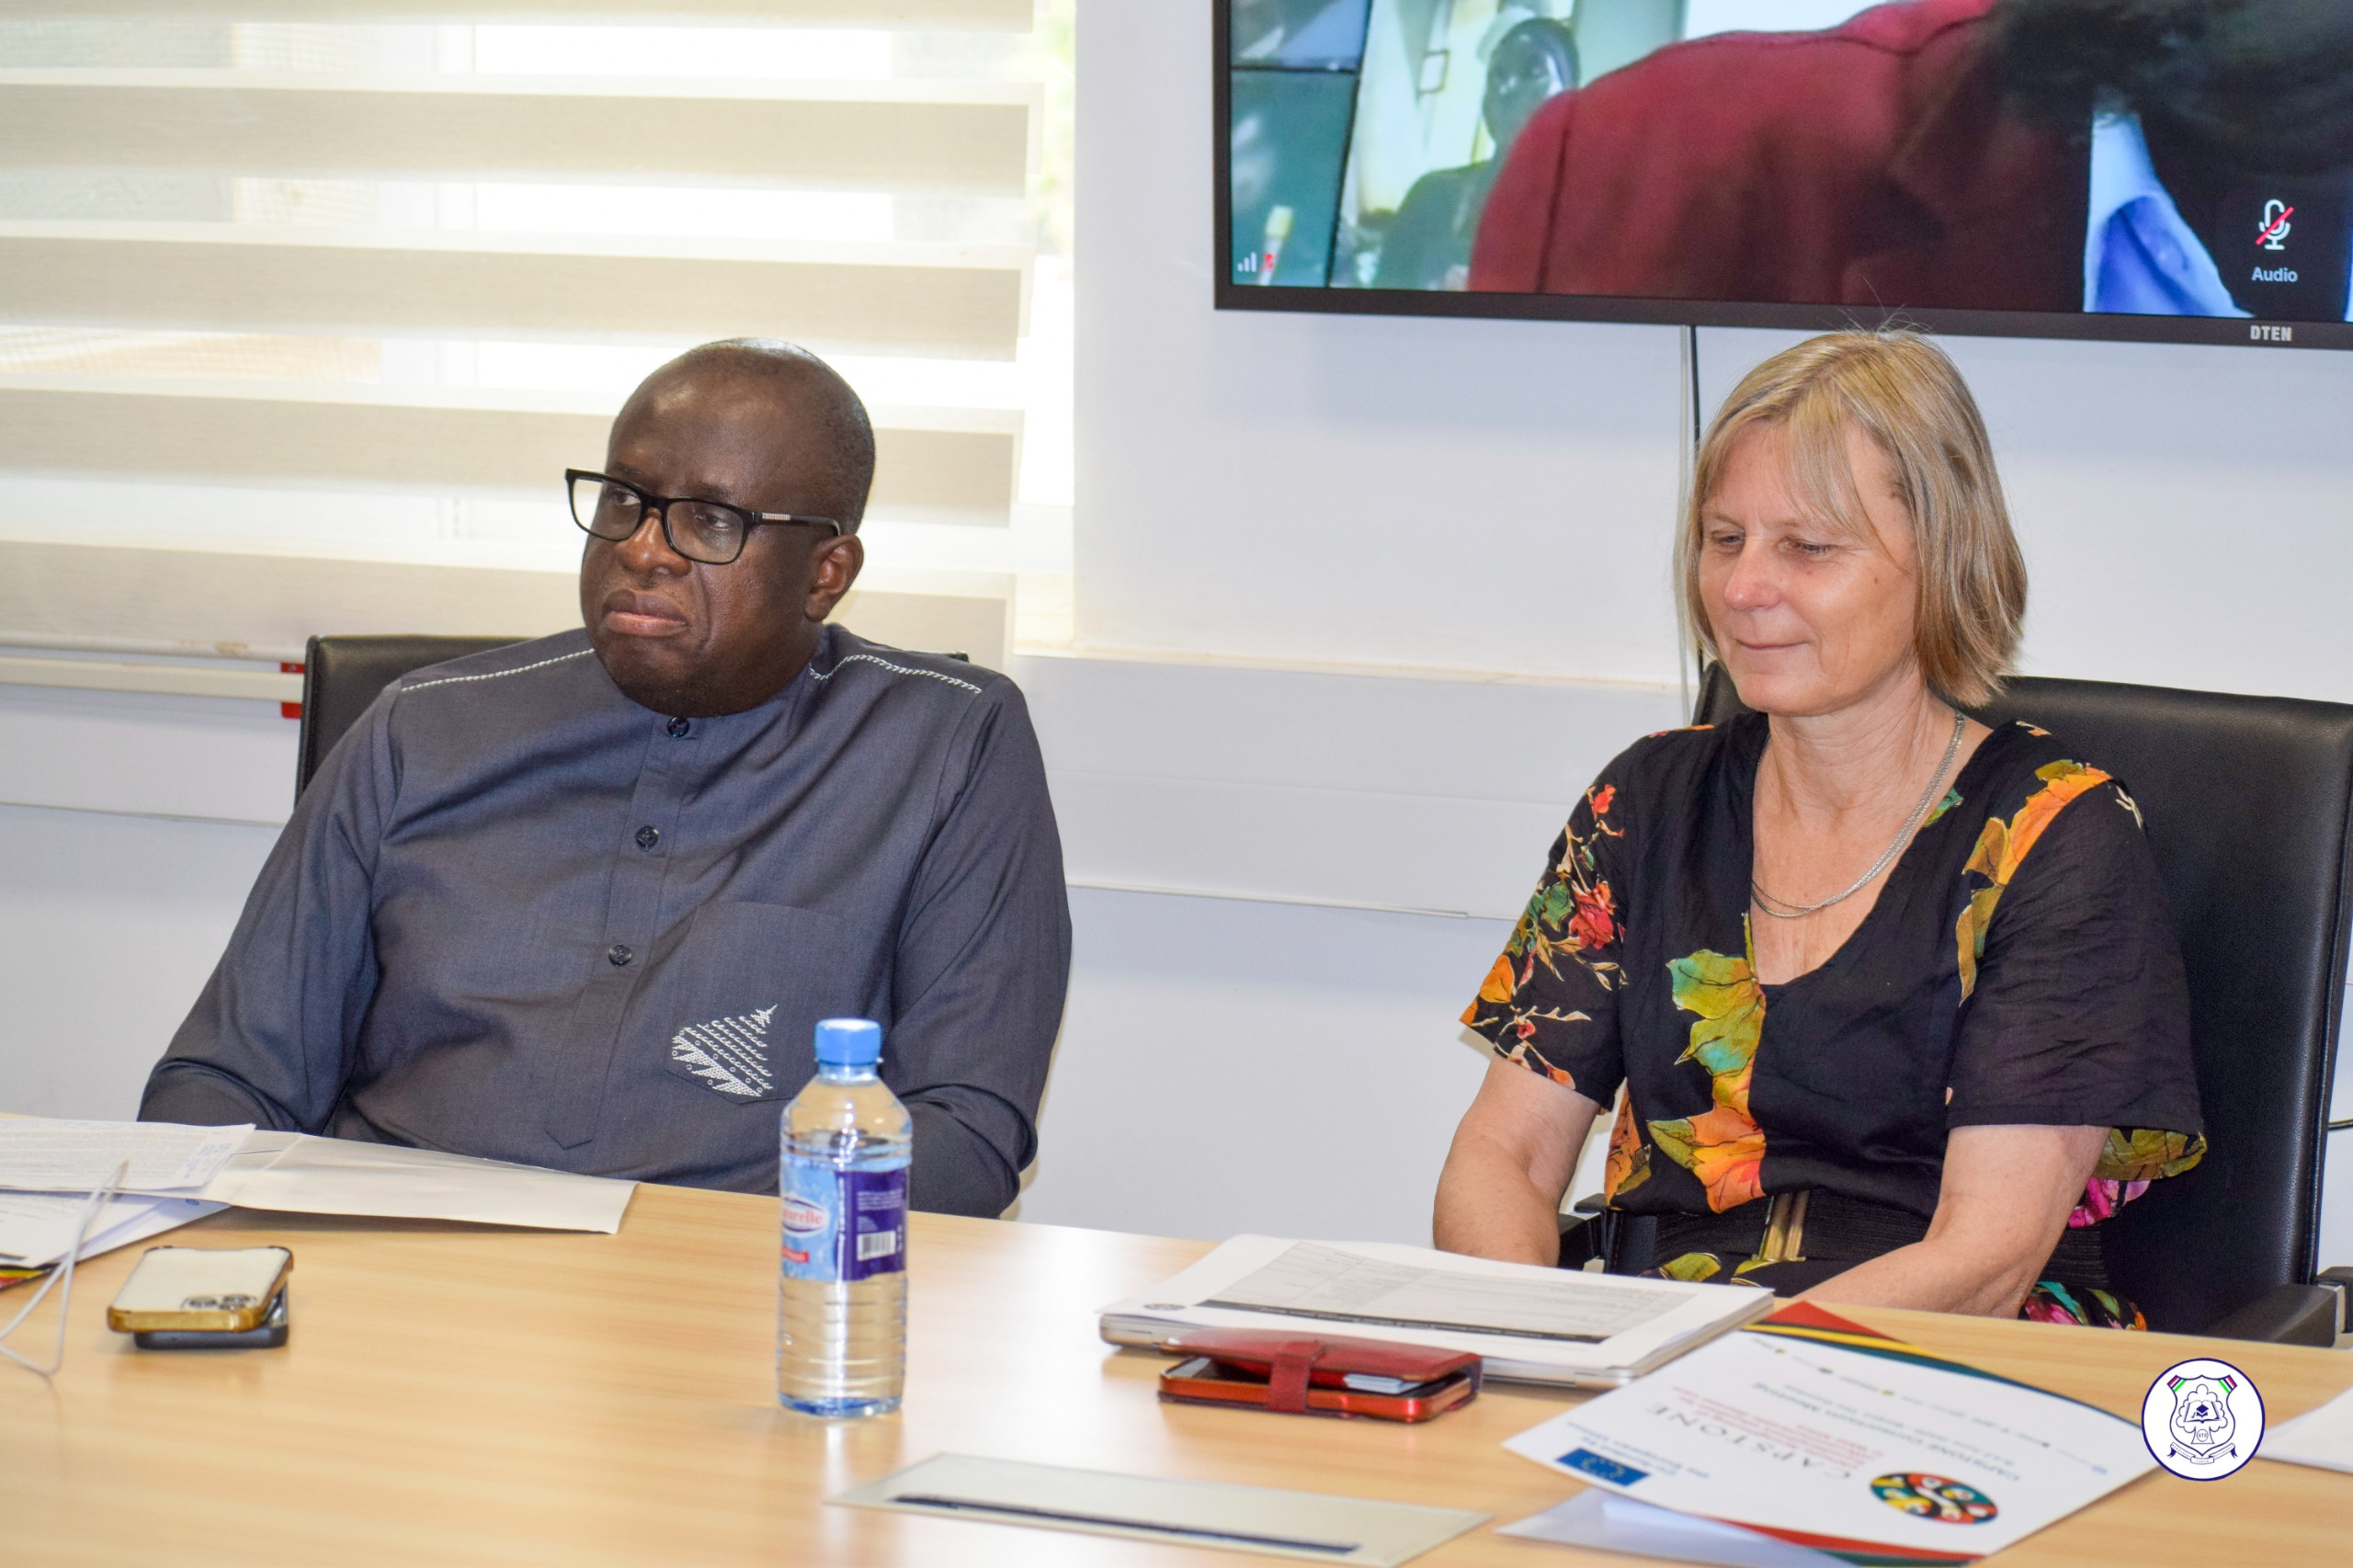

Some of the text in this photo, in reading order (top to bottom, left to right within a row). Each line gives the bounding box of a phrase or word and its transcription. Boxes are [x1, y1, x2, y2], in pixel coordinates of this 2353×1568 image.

[2251, 267, 2298, 282] Audio
[2250, 325, 2292, 341] DTEN
[1643, 1403, 1852, 1480] CAPSTONE
